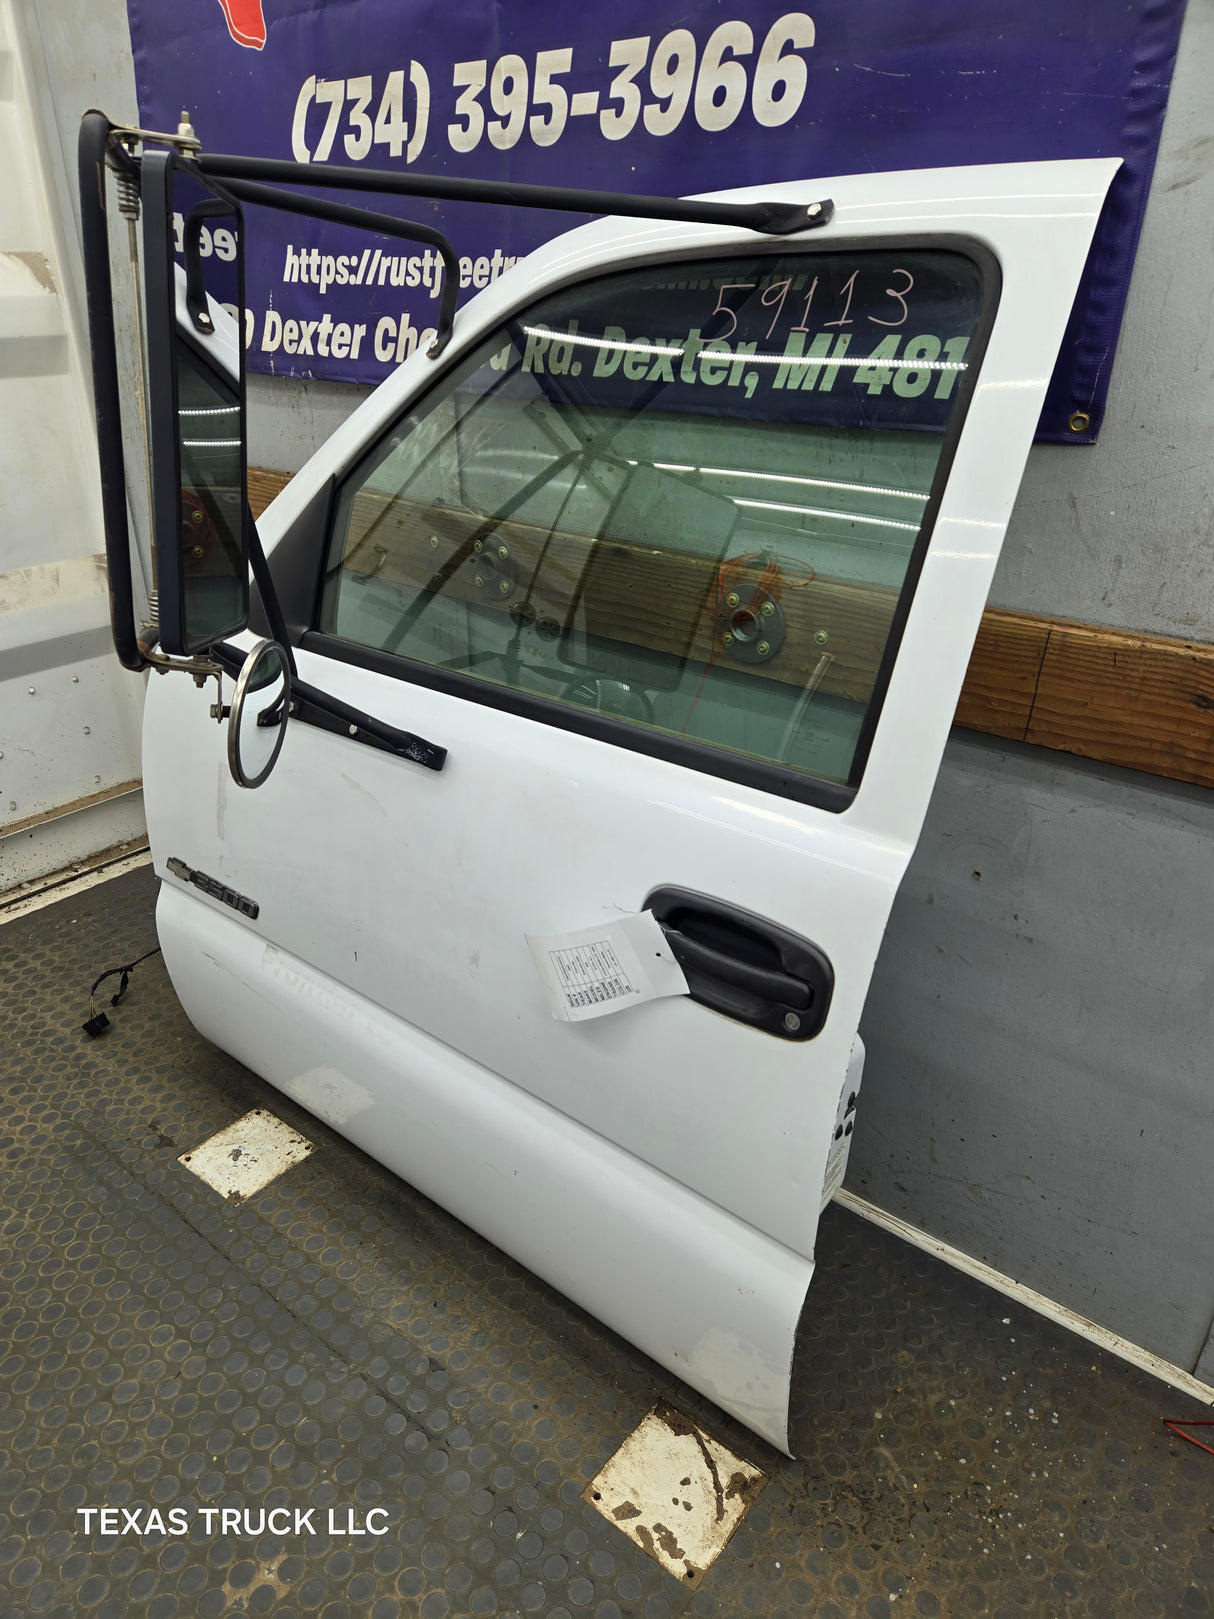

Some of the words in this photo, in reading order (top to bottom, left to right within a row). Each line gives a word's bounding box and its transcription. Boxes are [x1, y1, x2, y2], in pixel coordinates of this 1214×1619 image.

[291, 60, 430, 163] (734)
[448, 12, 815, 153] 395-3966
[695, 268, 914, 342] 59113
[261, 310, 366, 360] Dexter
[521, 320, 583, 377] Rd.
[592, 326, 758, 399] Dexter,
[772, 332, 853, 392] MI
